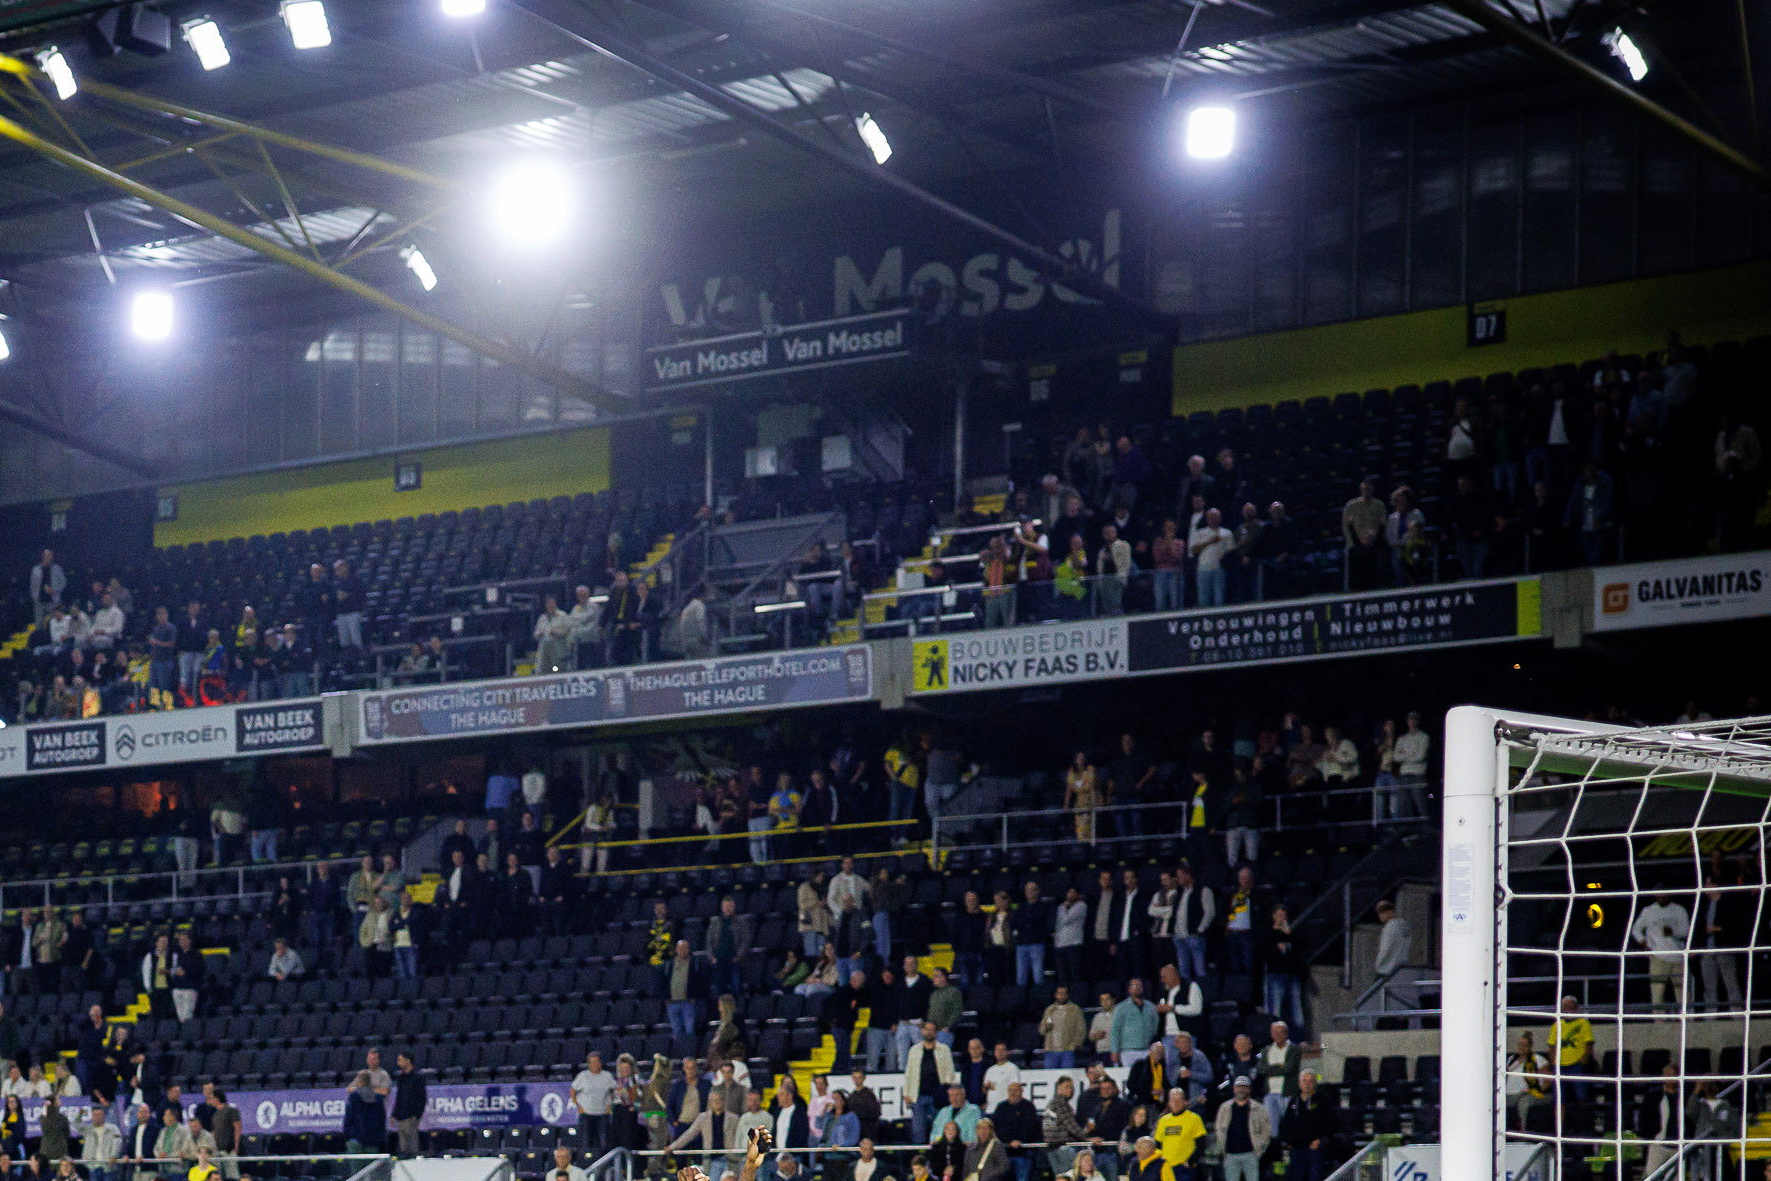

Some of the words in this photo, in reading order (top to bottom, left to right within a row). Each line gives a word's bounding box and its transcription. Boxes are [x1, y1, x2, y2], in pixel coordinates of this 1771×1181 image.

[783, 337, 822, 362] Van
[828, 322, 903, 354] Mossel
[655, 356, 691, 380] Van
[696, 342, 768, 374] Mossel
[1637, 568, 1762, 602] GALVANITAS
[1167, 609, 1315, 635] Verbouwingen
[1343, 592, 1475, 617] Timmerwerk
[1189, 625, 1303, 649] Onderhoud
[1330, 612, 1452, 635] Nieuwbouw
[952, 626, 1121, 661] BOUWBEDRIJF
[953, 658, 1017, 684] NICKY
[1024, 653, 1078, 677] FAAS
[1084, 650, 1125, 672] B.V.
[391, 692, 479, 714] CONNECTING
[482, 688, 512, 705] CITY
[515, 680, 597, 701] TRAVELLERS
[684, 690, 711, 707] THE
[714, 684, 767, 704] HAGUE
[243, 714, 274, 731] VAN
[276, 710, 315, 728] BEEK
[450, 711, 477, 728] THE
[478, 707, 526, 726] HAGUE
[33, 734, 62, 750] VAN
[64, 730, 99, 748] BEEK
[140, 725, 228, 749] CITROËN
[243, 726, 315, 744] AUTOGROEP
[33, 745, 99, 764] AUTOGROEP
[280, 1101, 322, 1117] ALPHA
[465, 1094, 518, 1112] GELENS
